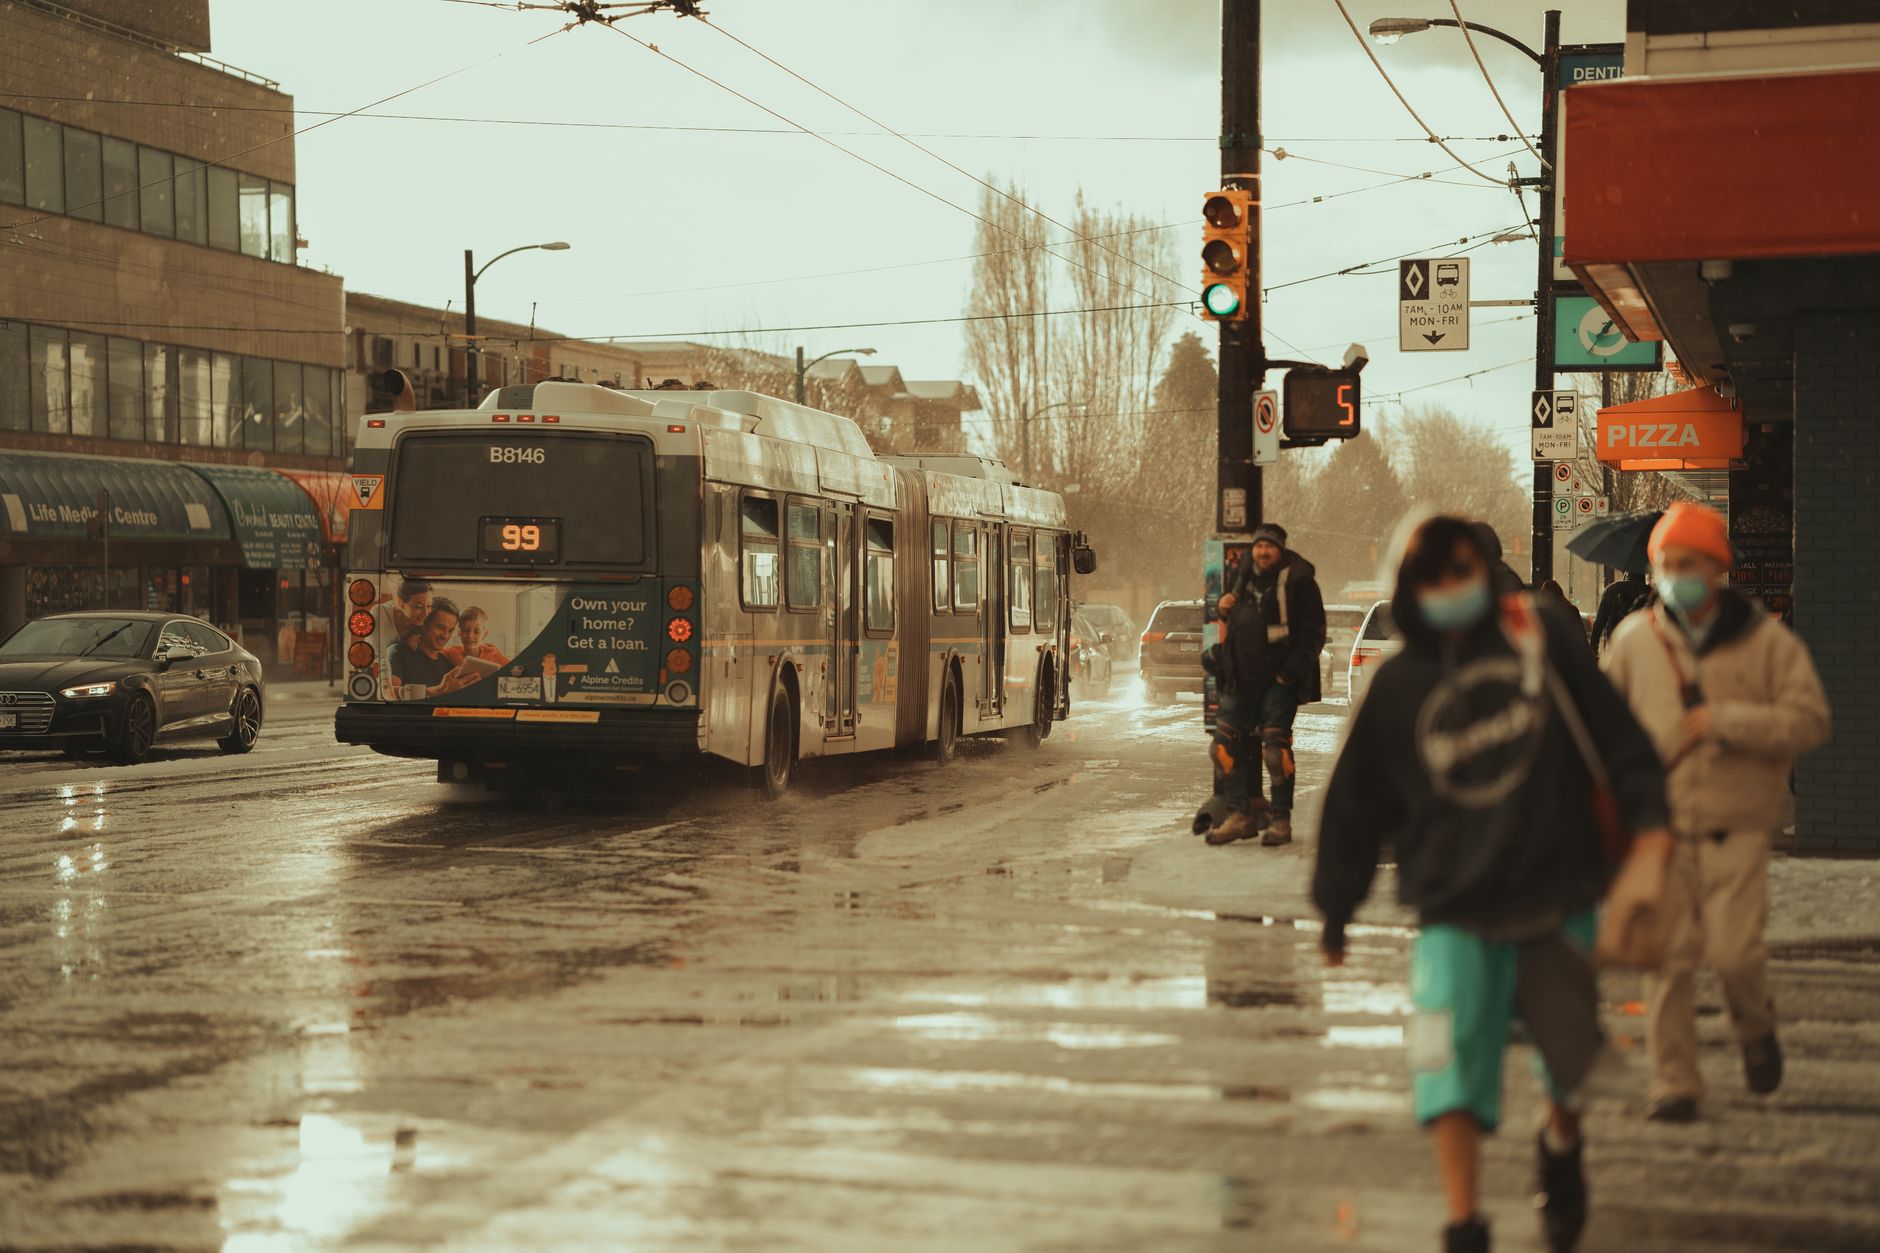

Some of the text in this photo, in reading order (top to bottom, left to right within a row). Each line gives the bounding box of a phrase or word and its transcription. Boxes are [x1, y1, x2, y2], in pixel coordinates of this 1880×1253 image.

[1438, 303, 1463, 314] 10AM
[1409, 315, 1459, 326] MON-FRI
[1337, 385, 1354, 425] 5
[1607, 423, 1701, 448] PIZZA
[1538, 441, 1571, 449] MON-FRI
[489, 446, 545, 464] B8146
[28, 503, 57, 522] Life
[114, 506, 158, 526] Centre
[501, 524, 540, 551] 99
[571, 598, 648, 614] Own your
[582, 616, 635, 631] home?
[567, 635, 649, 651] Get a loan.
[580, 675, 644, 685] Alpine Credits
